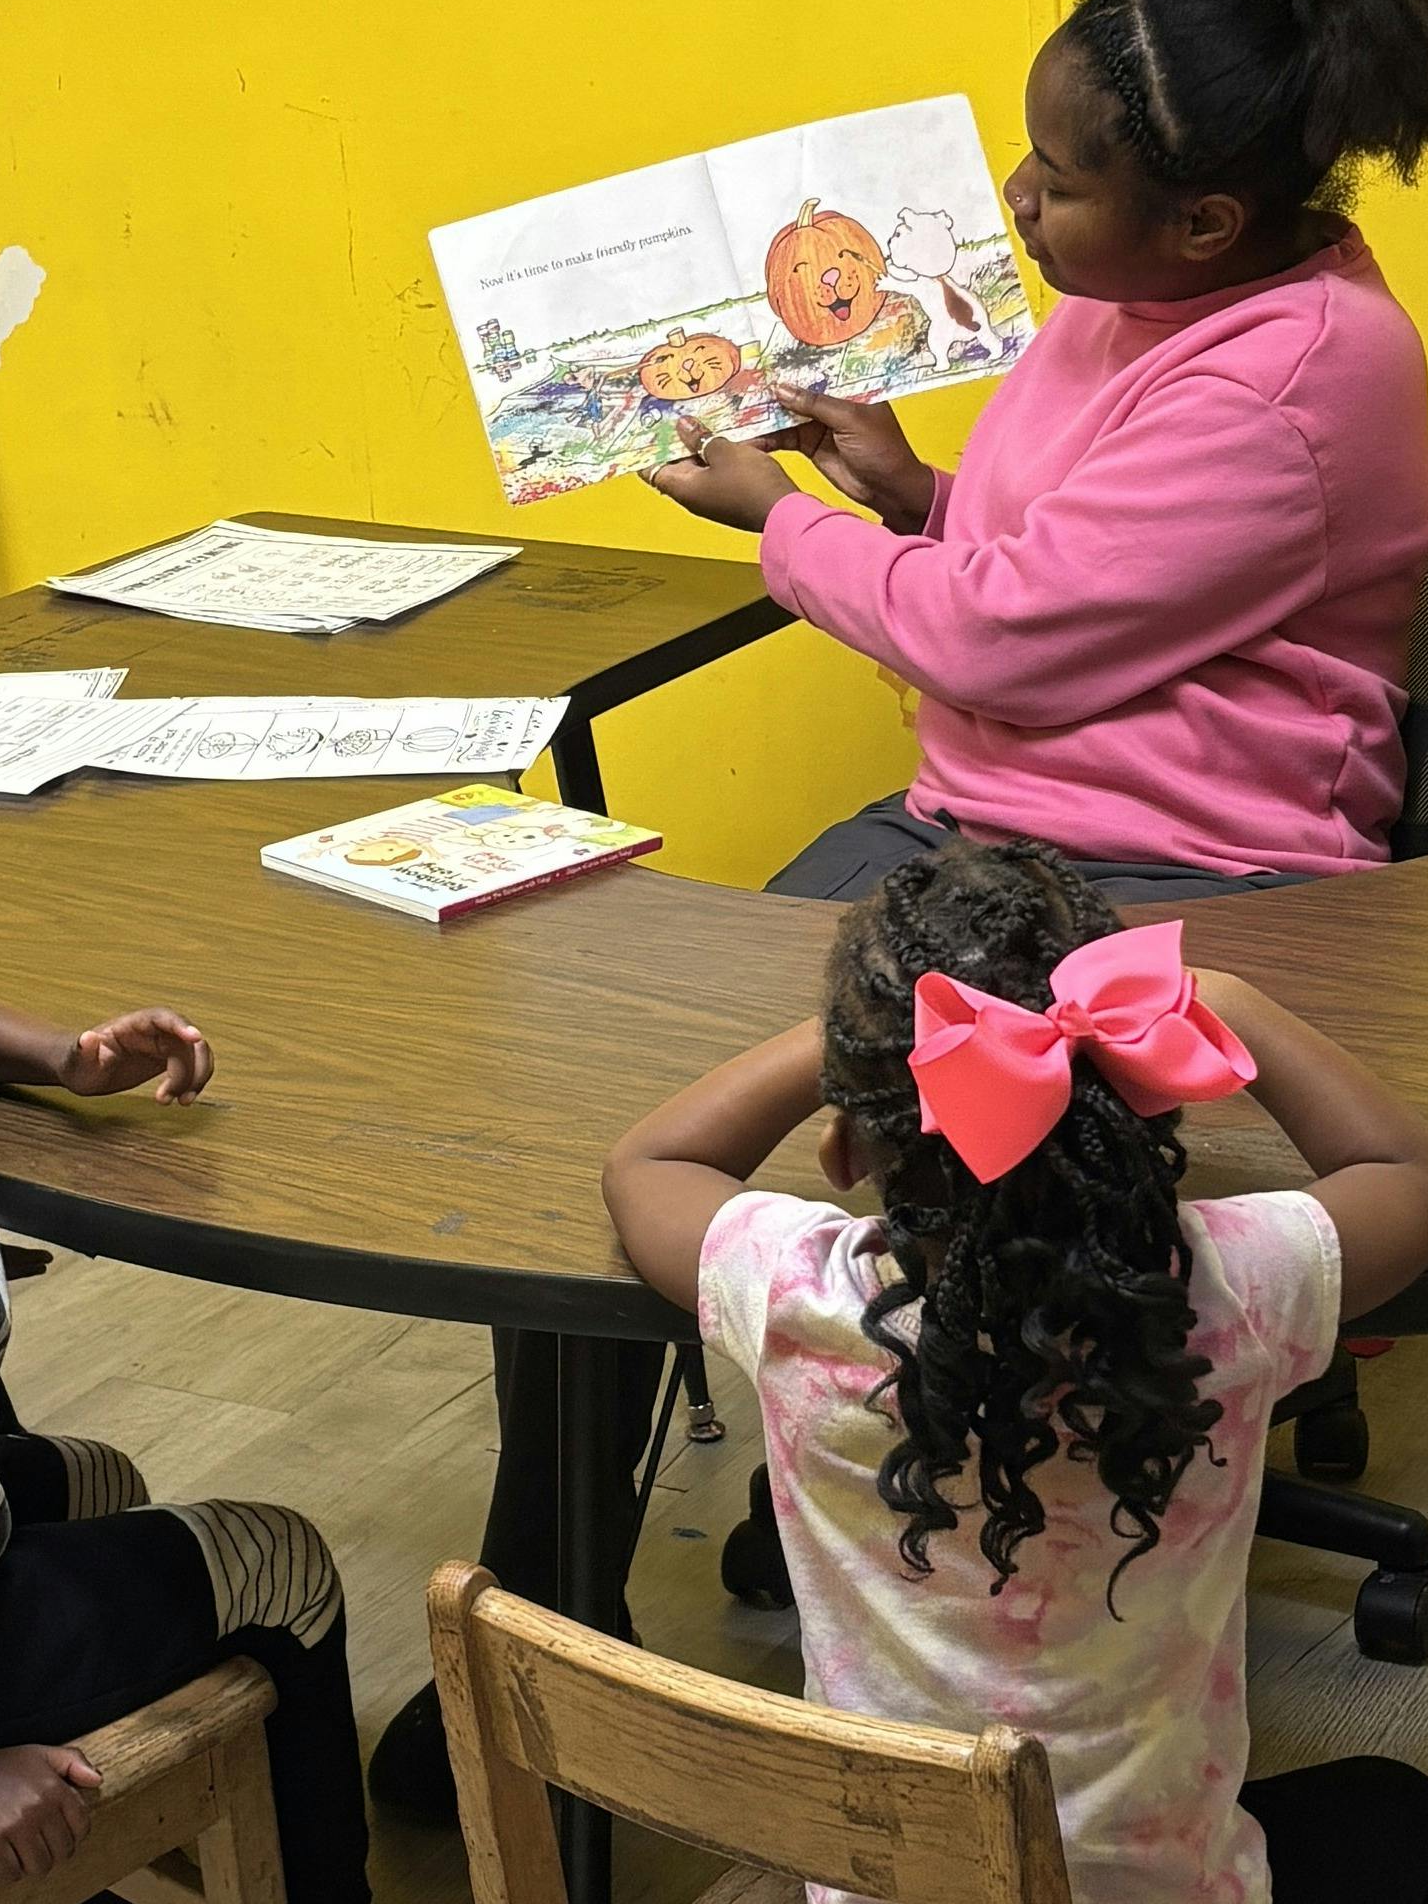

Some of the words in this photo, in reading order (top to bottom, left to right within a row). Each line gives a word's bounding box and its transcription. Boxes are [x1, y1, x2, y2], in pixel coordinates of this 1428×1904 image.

[525, 263, 549, 278] time
[551, 259, 563, 270] to
[565, 251, 594, 267] make
[596, 239, 636, 259] friendly
